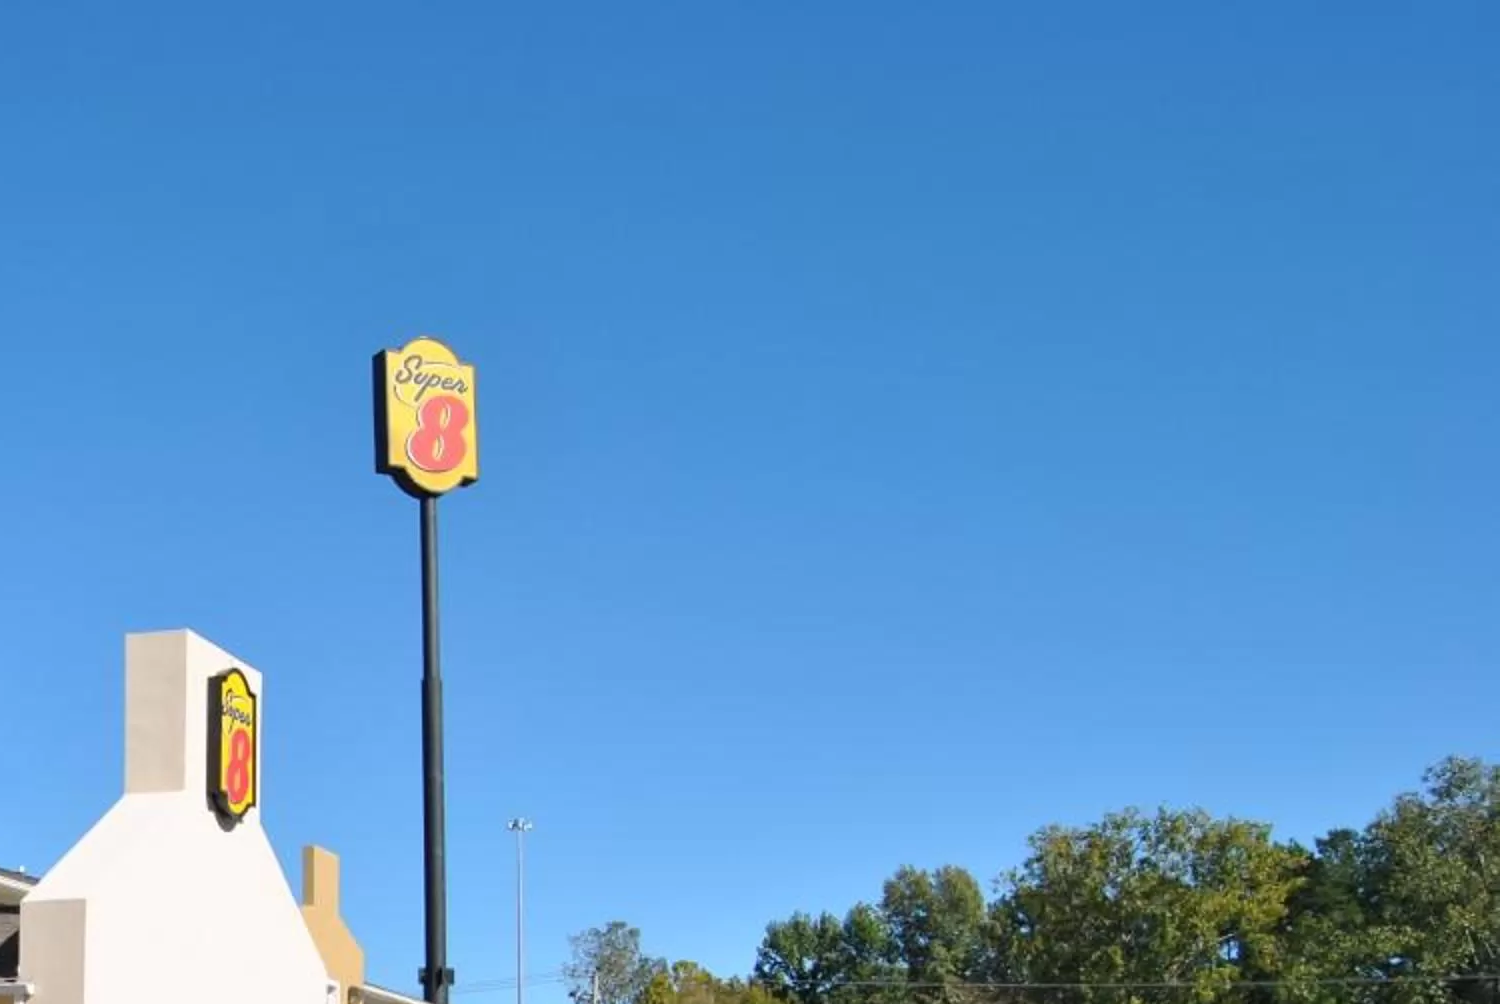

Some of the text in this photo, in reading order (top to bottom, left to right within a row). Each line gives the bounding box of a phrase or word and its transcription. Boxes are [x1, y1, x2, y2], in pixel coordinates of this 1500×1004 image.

[395, 354, 469, 402] Super
[406, 394, 470, 474] 8
[226, 727, 250, 805] 8
